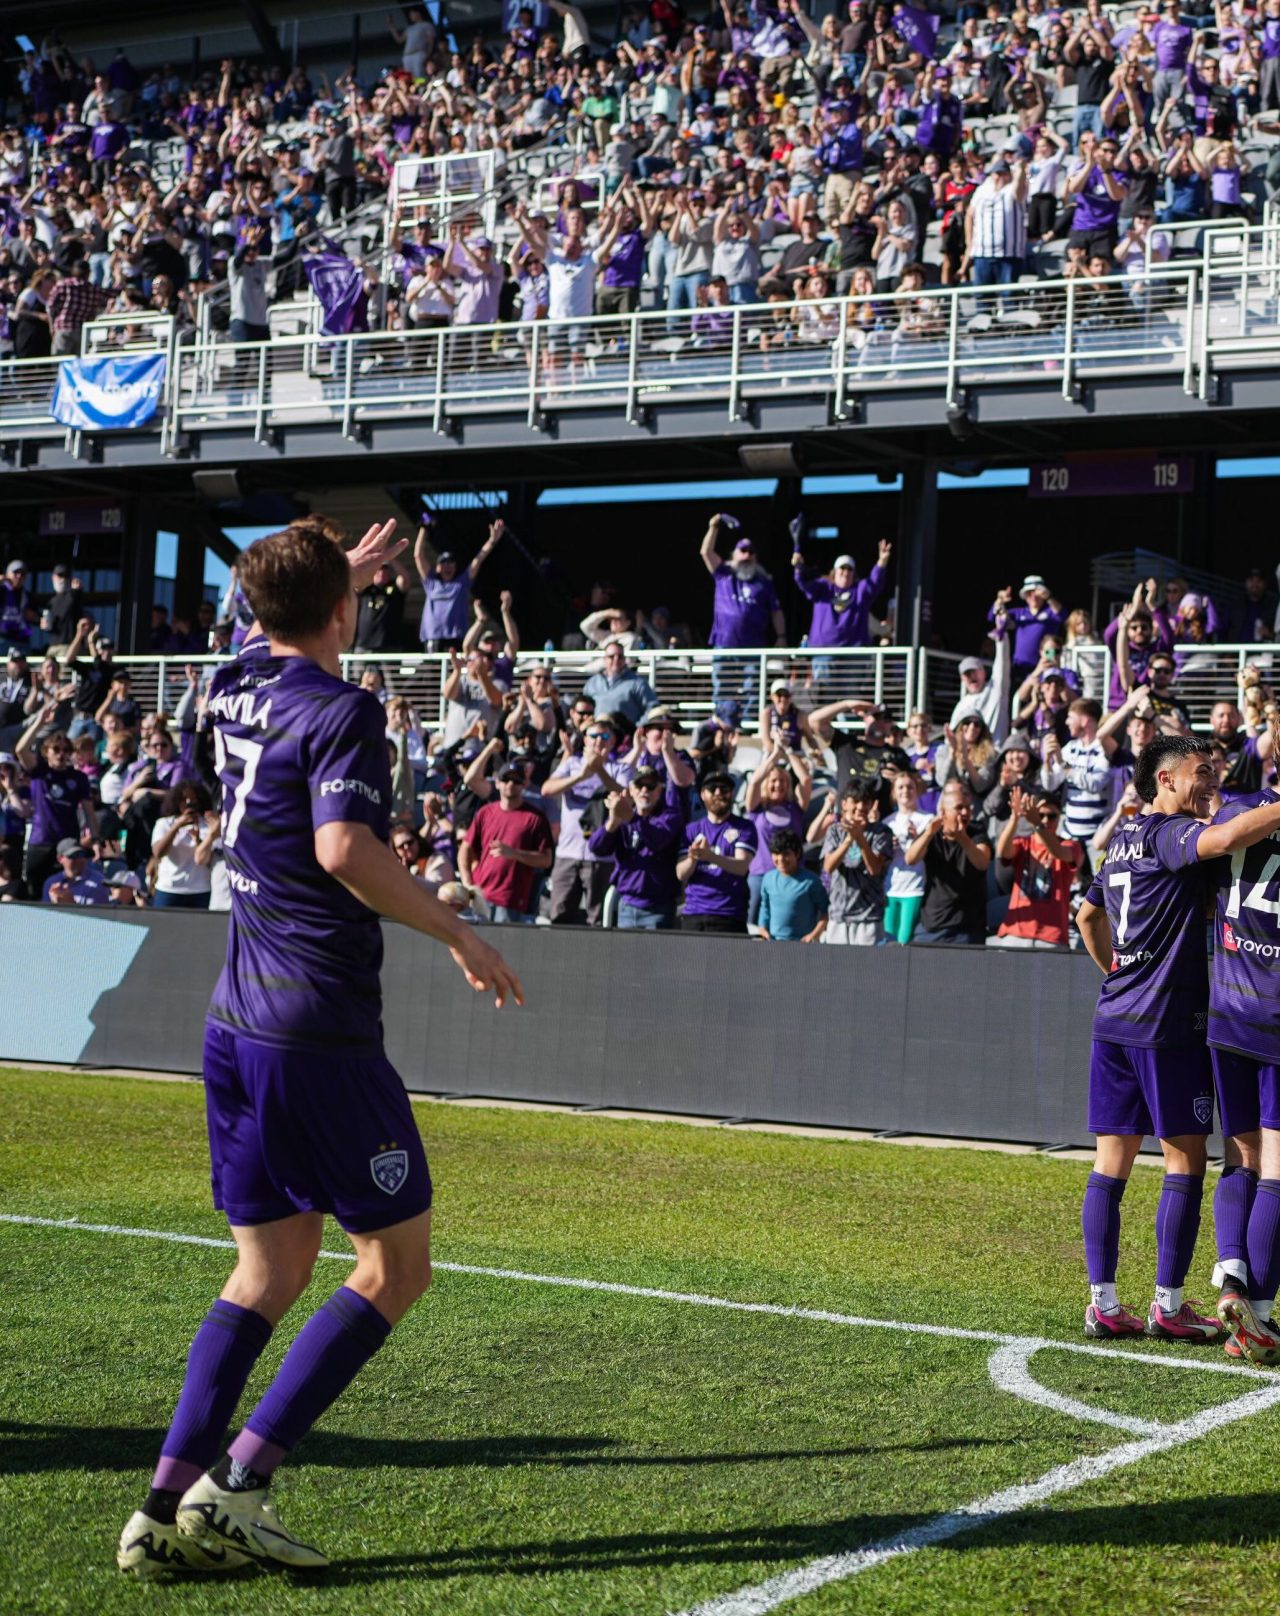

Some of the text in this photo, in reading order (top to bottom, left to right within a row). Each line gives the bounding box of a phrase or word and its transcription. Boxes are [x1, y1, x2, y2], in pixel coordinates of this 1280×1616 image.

[1041, 463, 1178, 491] 120 119
[320, 778, 382, 804] FORTNA
[1108, 871, 1132, 945] 7
